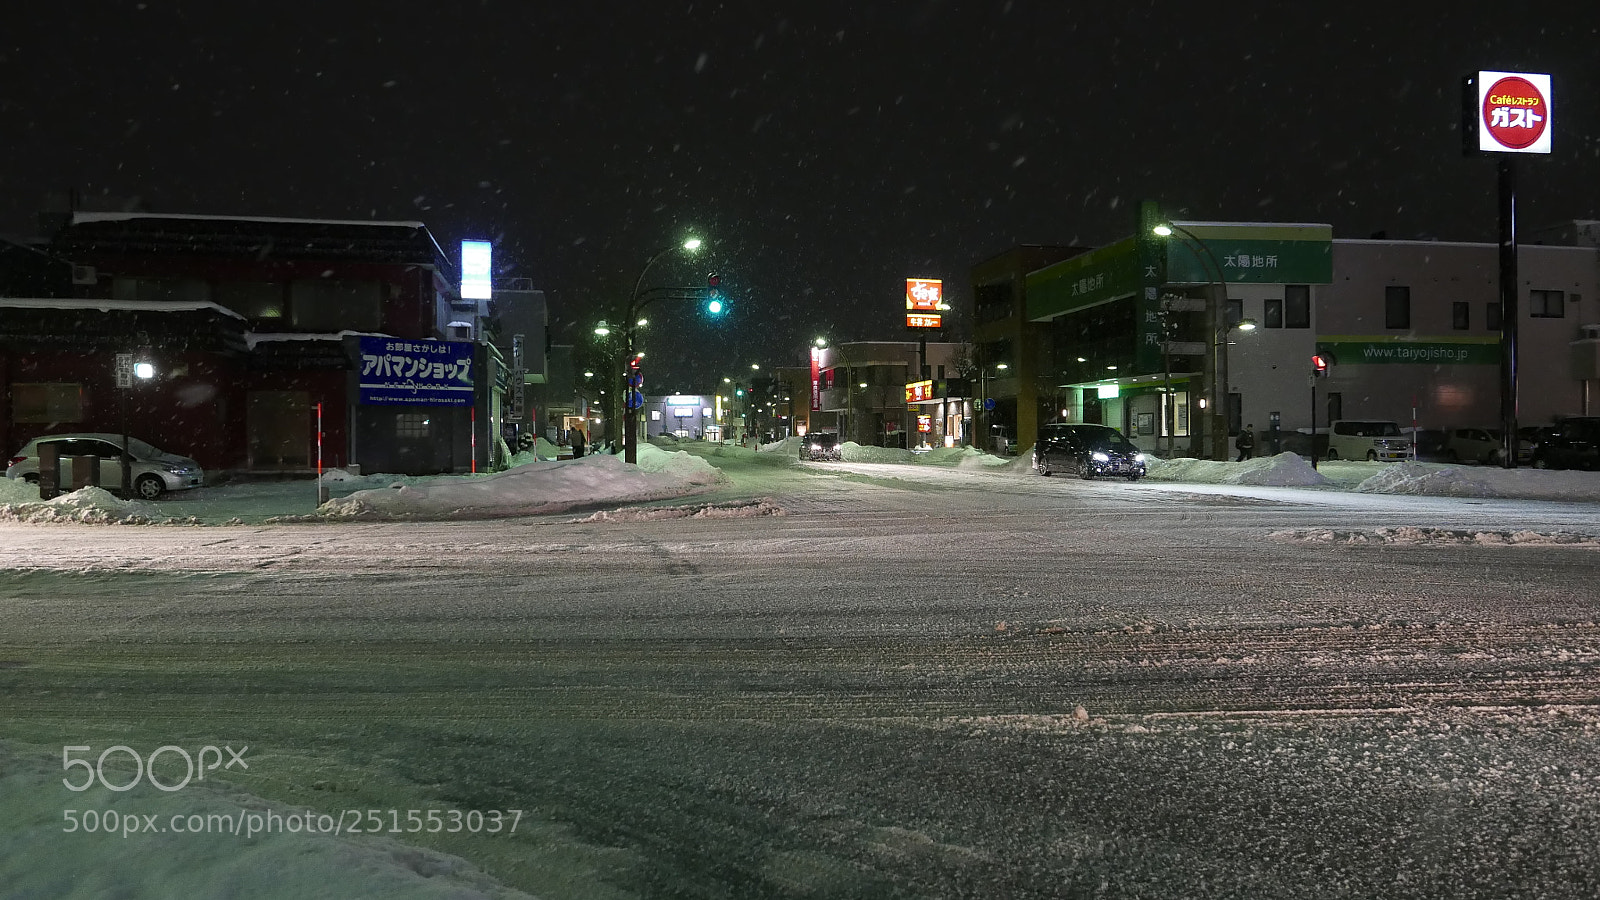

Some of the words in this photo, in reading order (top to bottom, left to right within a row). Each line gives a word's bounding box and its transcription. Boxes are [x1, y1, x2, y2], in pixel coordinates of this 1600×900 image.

[1489, 95, 1539, 106] Caféレストラン
[1491, 106, 1543, 129] ガスト
[1224, 254, 1278, 268] 太陽地所
[1071, 273, 1104, 297] 太陽地所
[1144, 265, 1158, 345] 太陽地所
[1363, 346, 1469, 361] www.taiyojisho.jp
[362, 353, 472, 379] アパマンショップ
